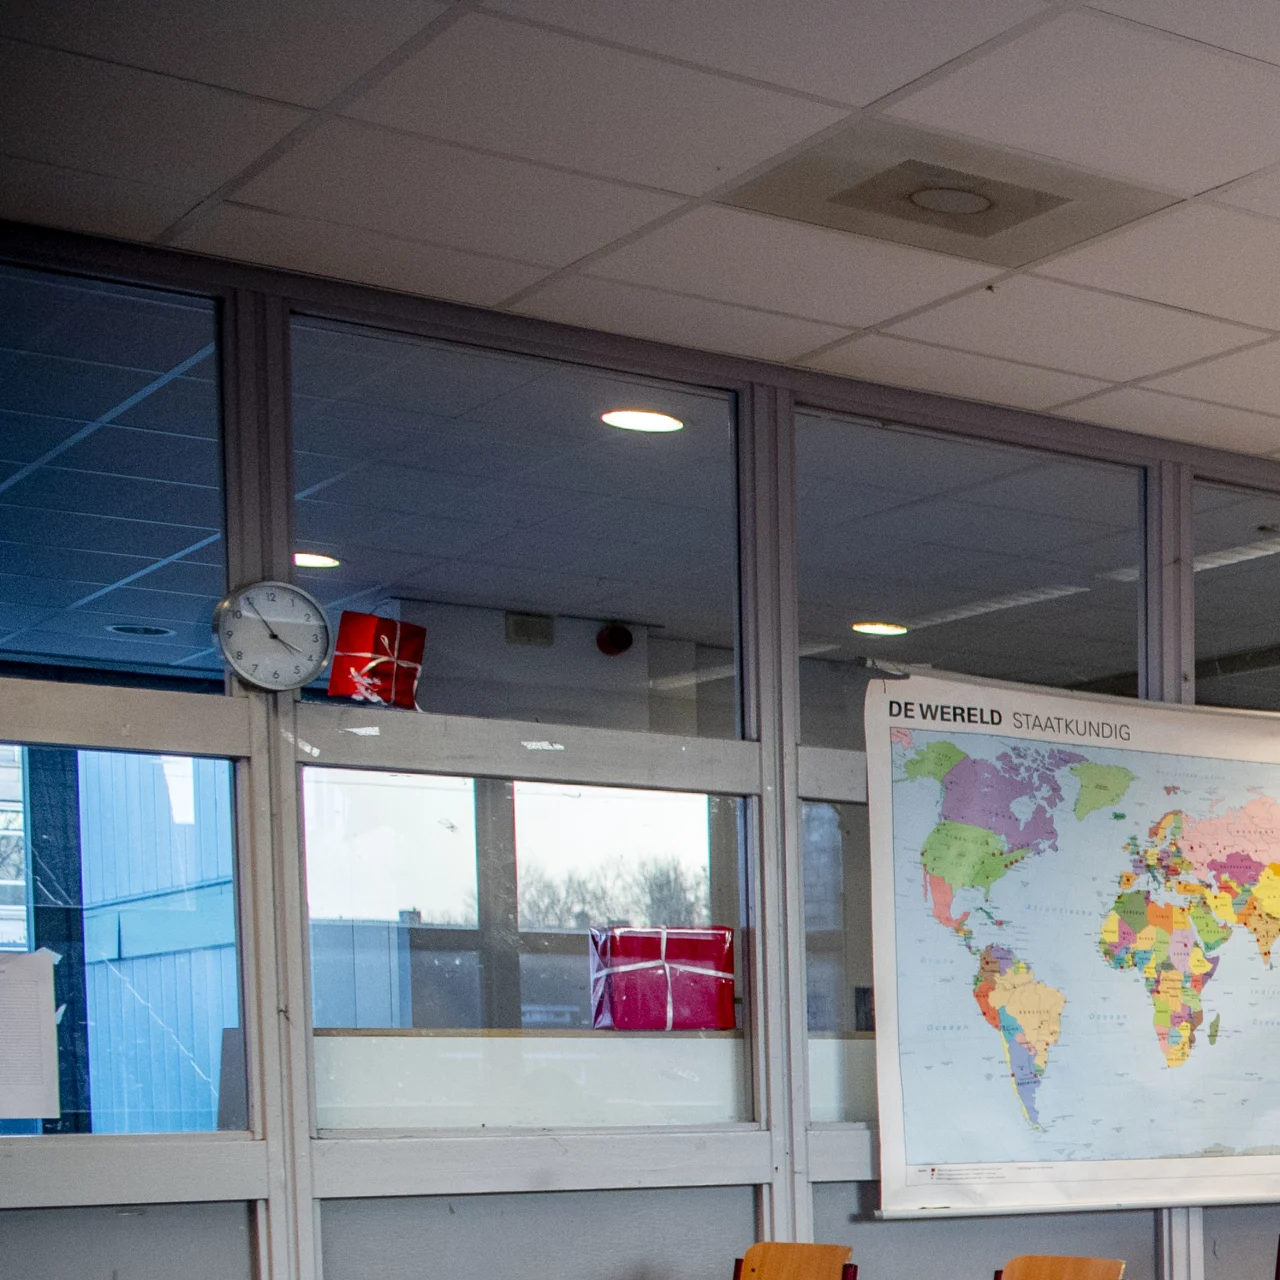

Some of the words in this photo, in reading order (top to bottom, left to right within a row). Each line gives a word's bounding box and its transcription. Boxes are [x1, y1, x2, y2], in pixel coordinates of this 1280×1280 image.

[265, 592, 276, 602] 12
[231, 610, 242, 619] 10
[304, 613, 310, 621] 2
[226, 630, 233, 639] 9
[312, 634, 318, 643] 3
[236, 651, 243, 660] 8
[252, 664, 258, 673] 7
[294, 665, 300, 674] 5
[273, 670, 279, 679] 6
[889, 700, 915, 719] DE
[919, 703, 1002, 725] WERELD
[1013, 712, 1130, 741] STAATKUNDIG
